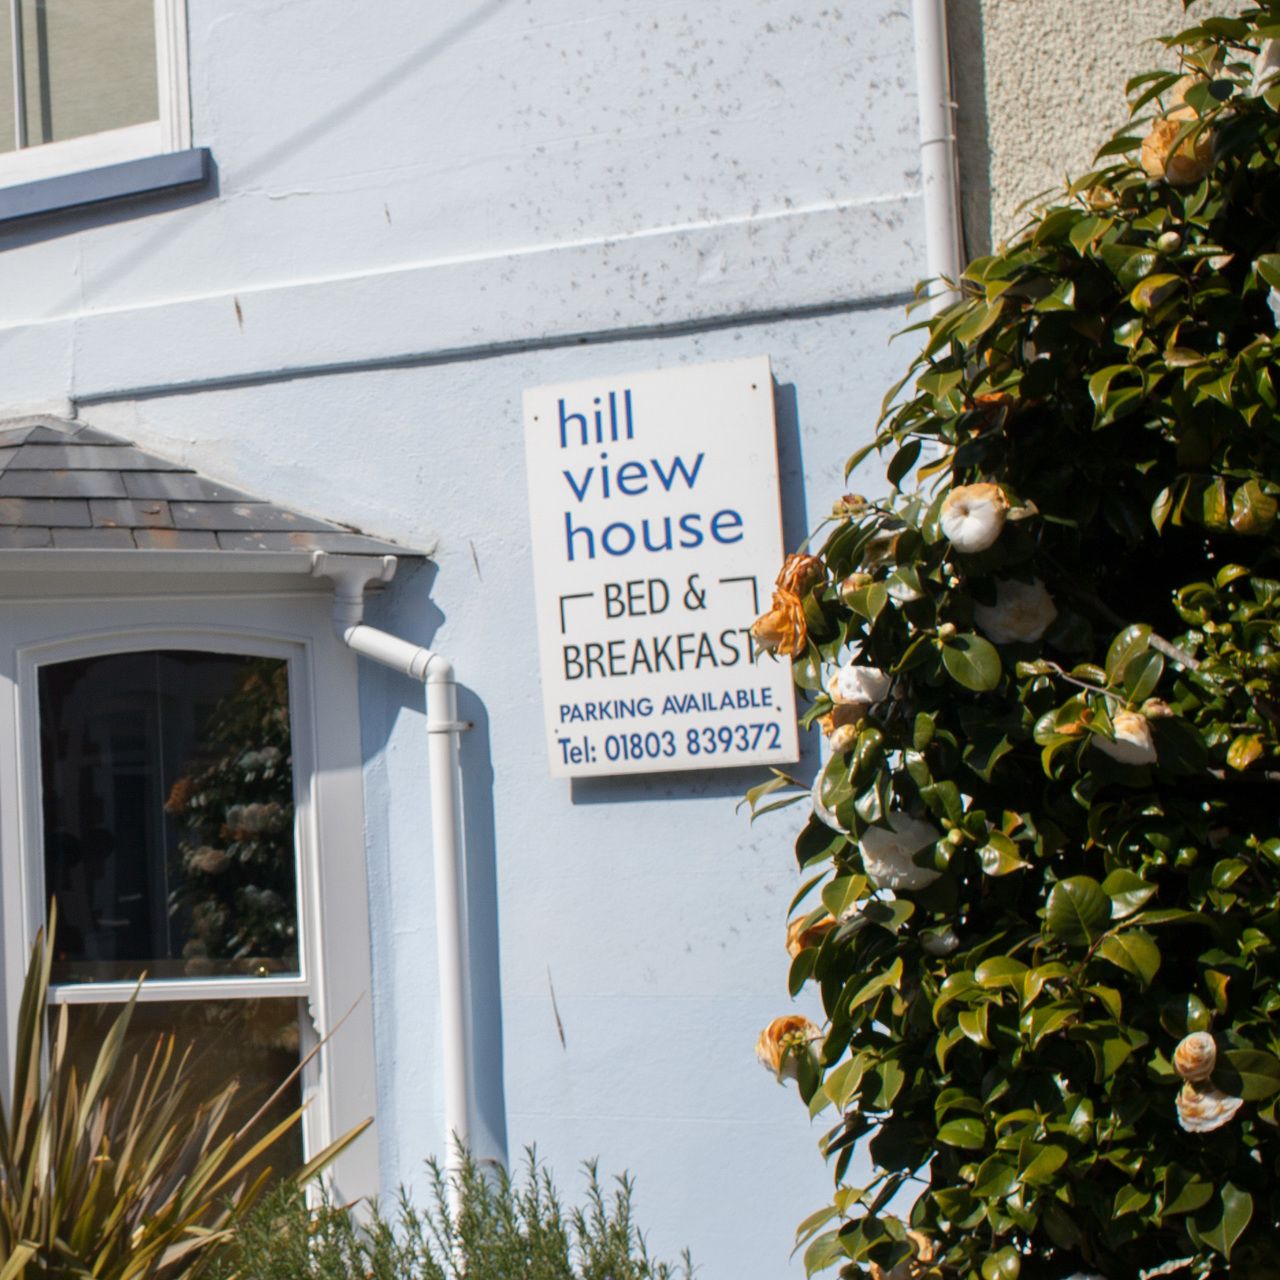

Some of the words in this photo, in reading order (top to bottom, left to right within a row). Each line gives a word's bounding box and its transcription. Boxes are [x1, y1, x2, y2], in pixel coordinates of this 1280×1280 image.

[558, 388, 635, 449] hill
[562, 451, 705, 503] view
[564, 508, 745, 562] house
[604, 577, 671, 620] BED
[683, 573, 707, 612] &
[562, 626, 757, 681] BREAKFAST
[559, 697, 654, 724] PARKING
[661, 686, 773, 716] AVAILABLE
[557, 735, 597, 765] Tel:
[604, 729, 678, 763] 01803
[686, 721, 783, 756] 839372
